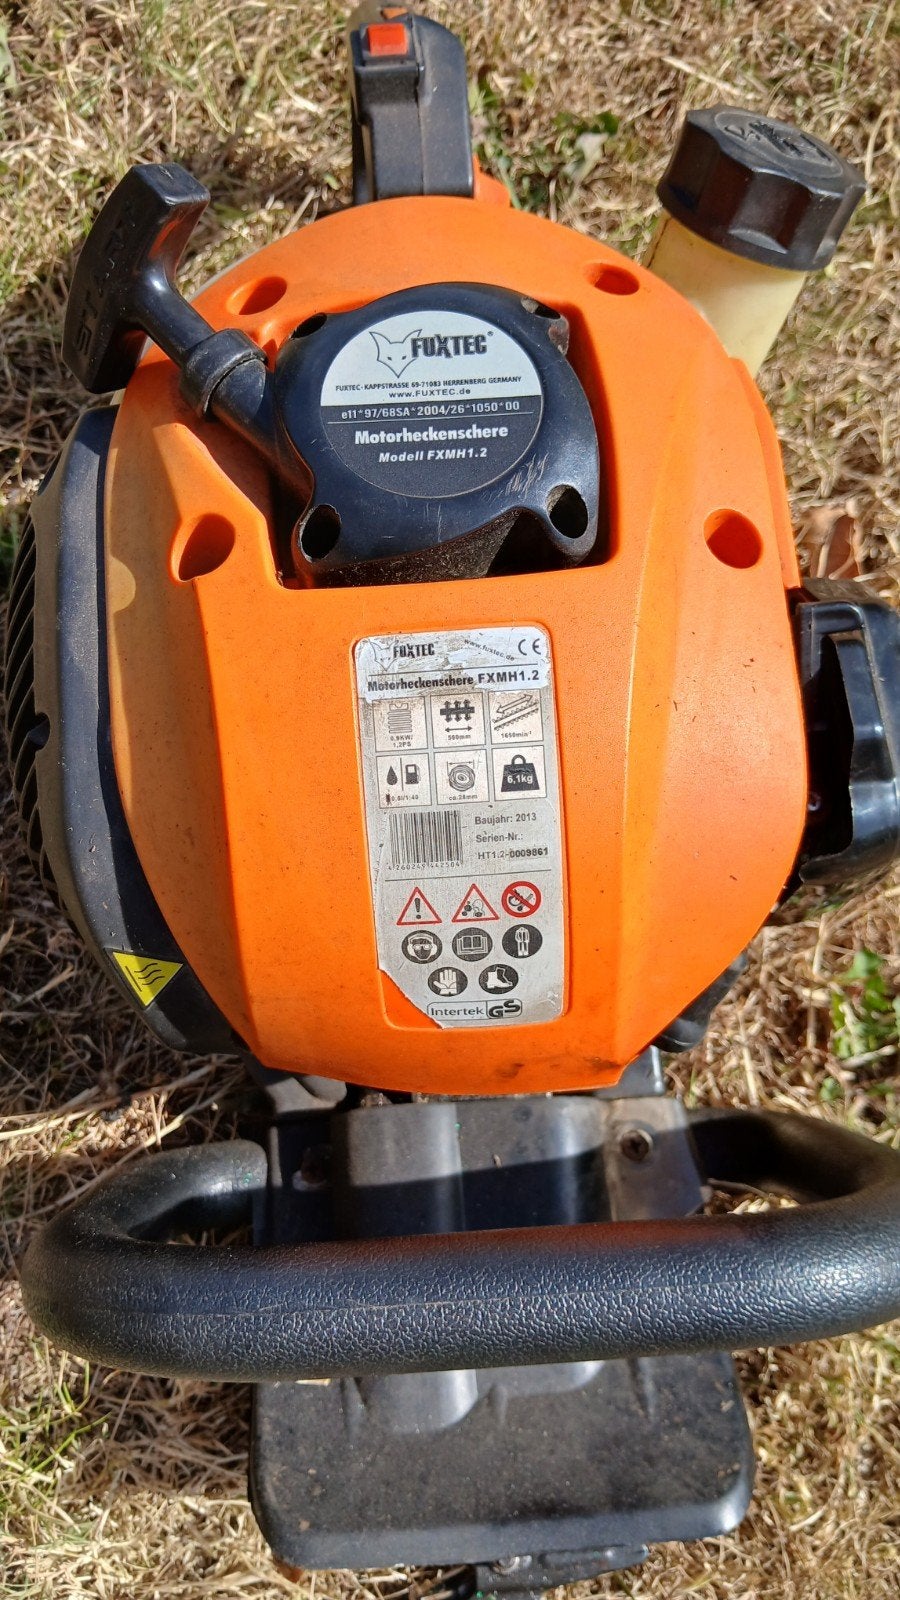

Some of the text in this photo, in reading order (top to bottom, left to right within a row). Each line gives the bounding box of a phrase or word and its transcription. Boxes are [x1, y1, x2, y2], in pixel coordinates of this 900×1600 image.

[411, 379, 441, 388] 69-71083
[443, 377, 487, 387] HERRENBERG
[488, 376, 522, 384] GERMANY
[388, 388, 471, 399] www.FUXTEC.de
[354, 424, 509, 445] Motorheckenschere
[378, 448, 487, 463] Modell FXMH1.2
[393, 643, 435, 659] FUXTEC
[464, 638, 516, 662] www.fuxtec.de
[367, 670, 540, 692] Motorheckenschere FXMH1.2
[507, 774, 533, 784] 6,1kg
[474, 812, 537, 826] Baujahr: 2013
[475, 832, 524, 843] Serien-Nr.:
[477, 847, 549, 860] HT1.2-0009861
[431, 1000, 521, 1018] Intertek GS
